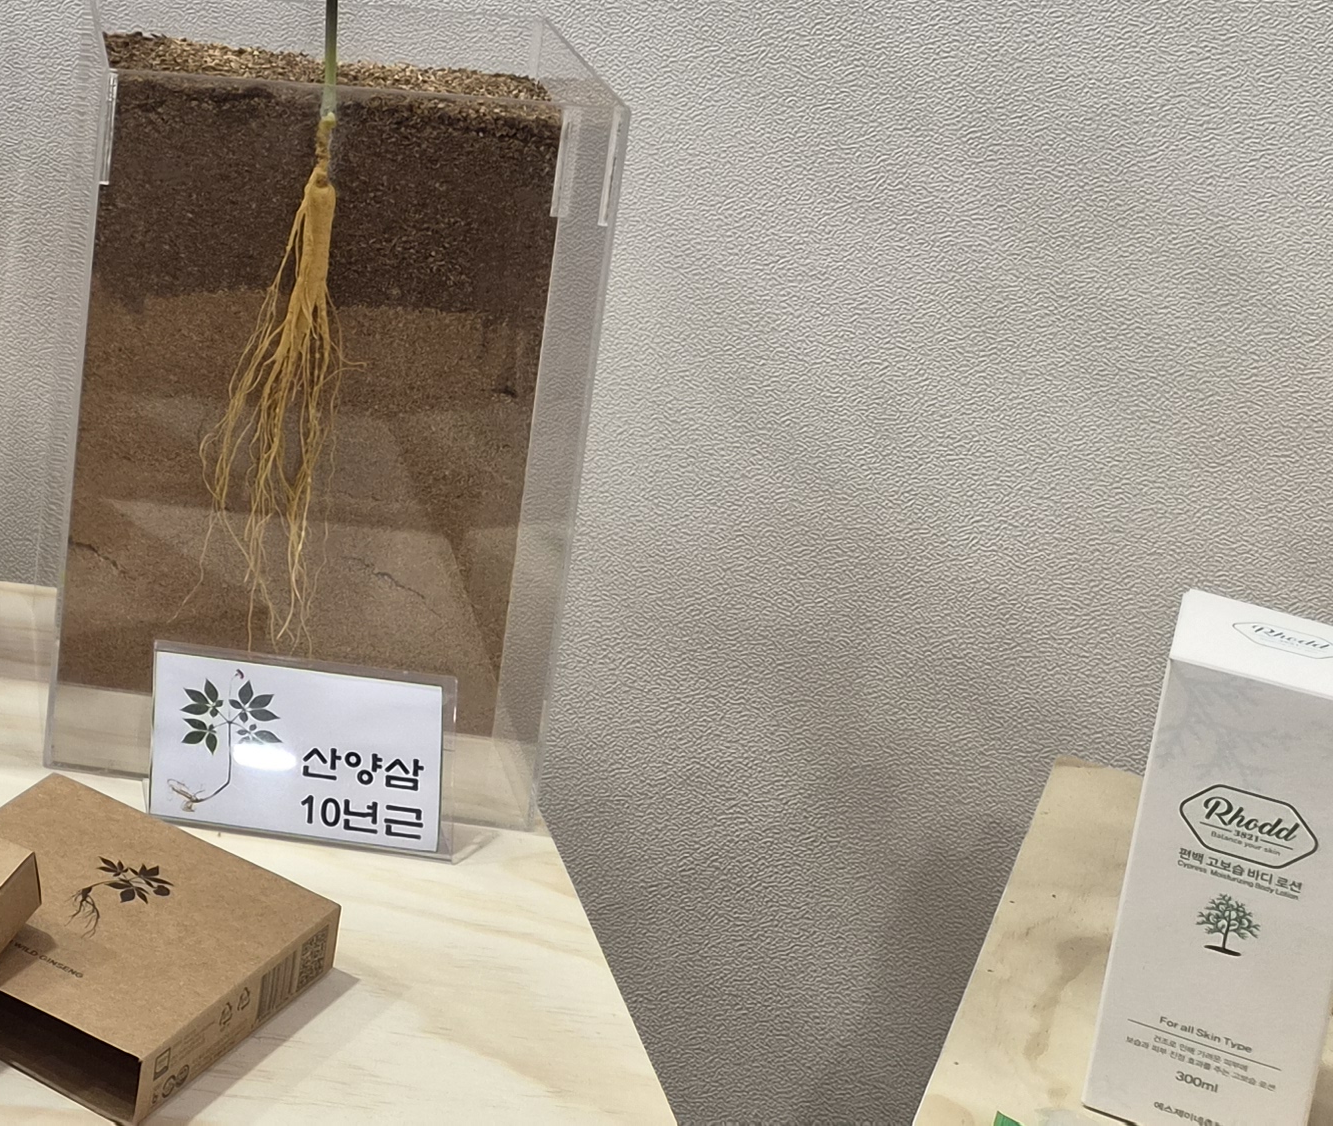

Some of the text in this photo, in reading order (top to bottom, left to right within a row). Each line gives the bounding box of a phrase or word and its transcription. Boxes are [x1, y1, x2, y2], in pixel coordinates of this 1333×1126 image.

[1251, 624, 1331, 650] Rhodd
[301, 747, 425, 792] 산양삼
[300, 794, 424, 840] 10년근
[1202, 795, 1301, 842] Rhodd
[1233, 829, 1260, 843] 3821
[1210, 830, 1281, 856] Balance your skin
[1177, 859, 1208, 874] Cypress
[1254, 882, 1275, 894] Body
[1275, 888, 1299, 901] Lotion
[1178, 847, 1303, 894] 편백 고보습 바디 로션
[13, 941, 84, 979] WILD GINSENG
[1159, 1016, 1253, 1054] For all Skin Type
[1175, 1070, 1219, 1094] 300ml
[1153, 1101, 1224, 1126] 에스제이네
